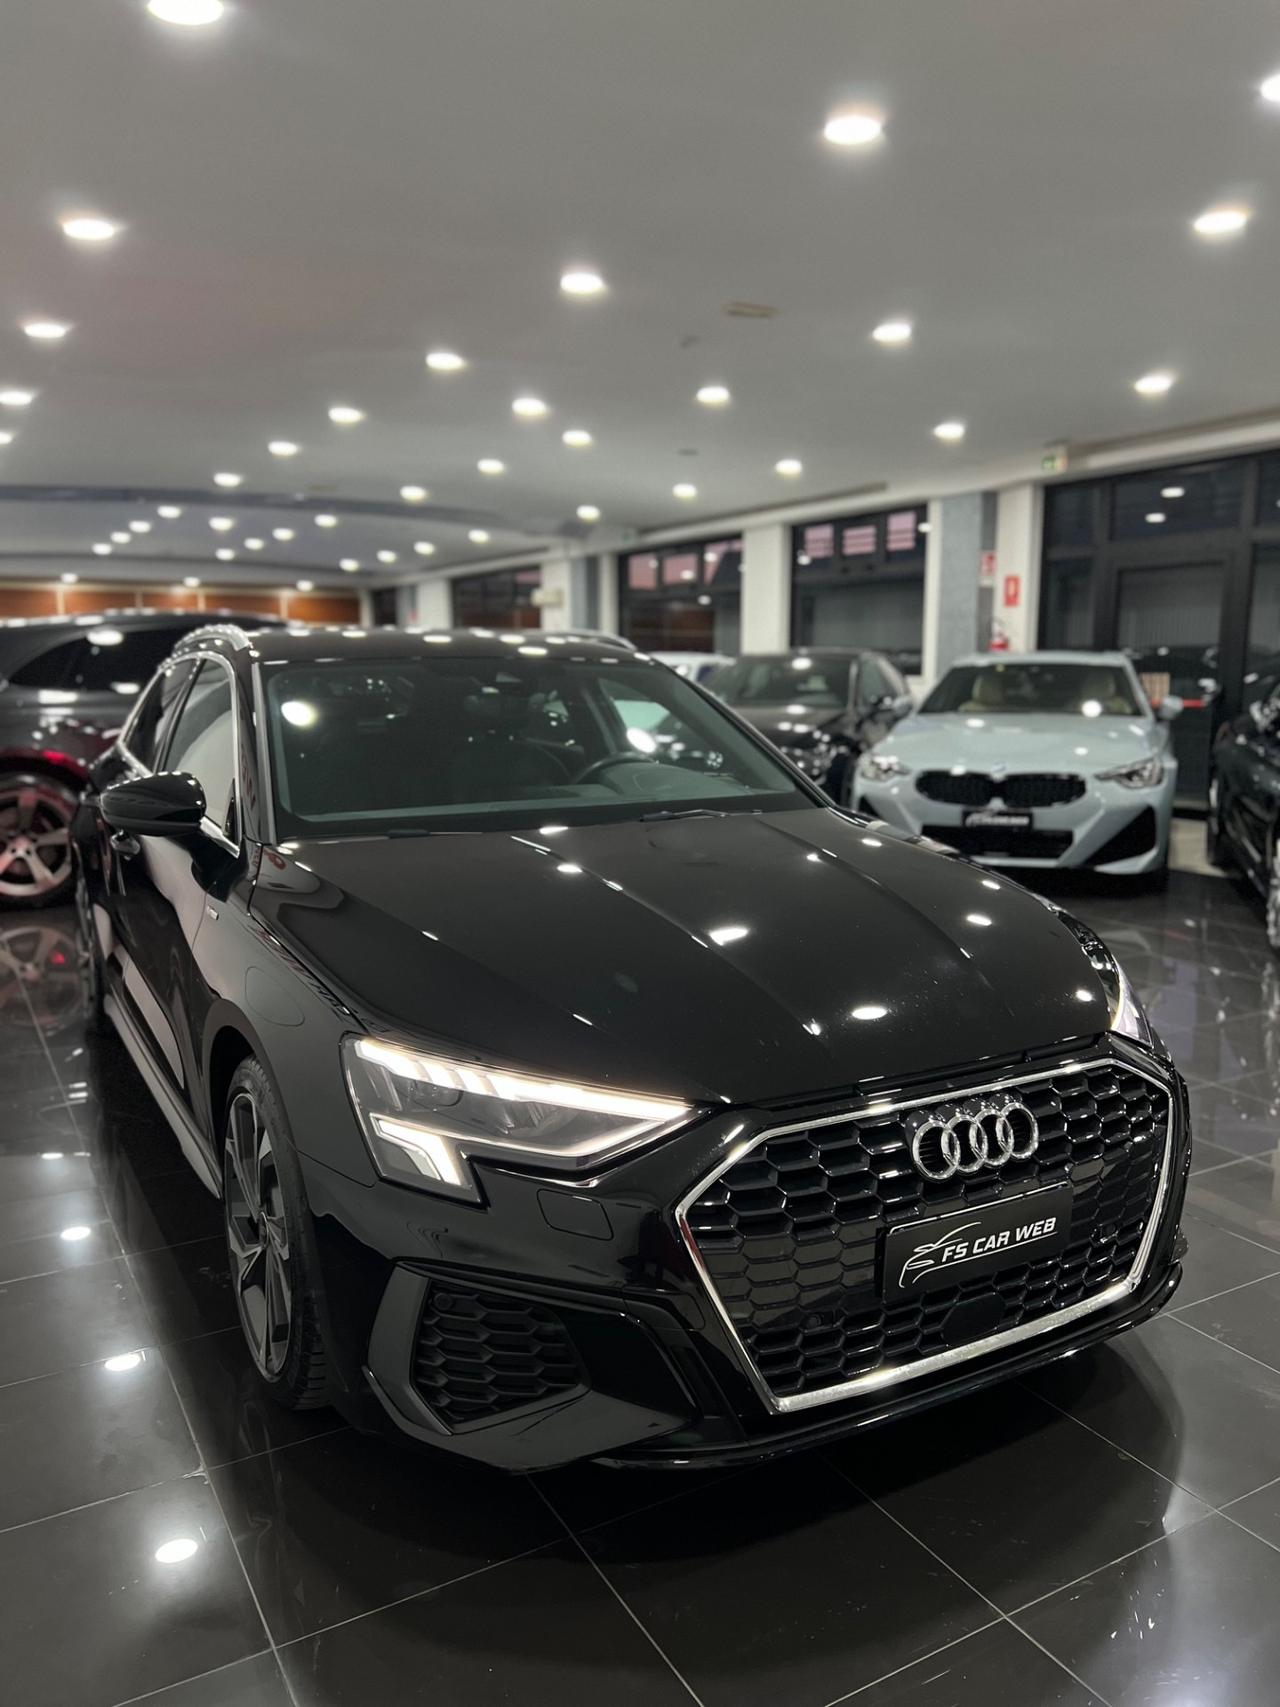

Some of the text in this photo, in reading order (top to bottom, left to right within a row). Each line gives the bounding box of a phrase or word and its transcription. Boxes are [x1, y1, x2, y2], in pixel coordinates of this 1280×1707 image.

[941, 1217, 1057, 1262] FS CAR WEB
